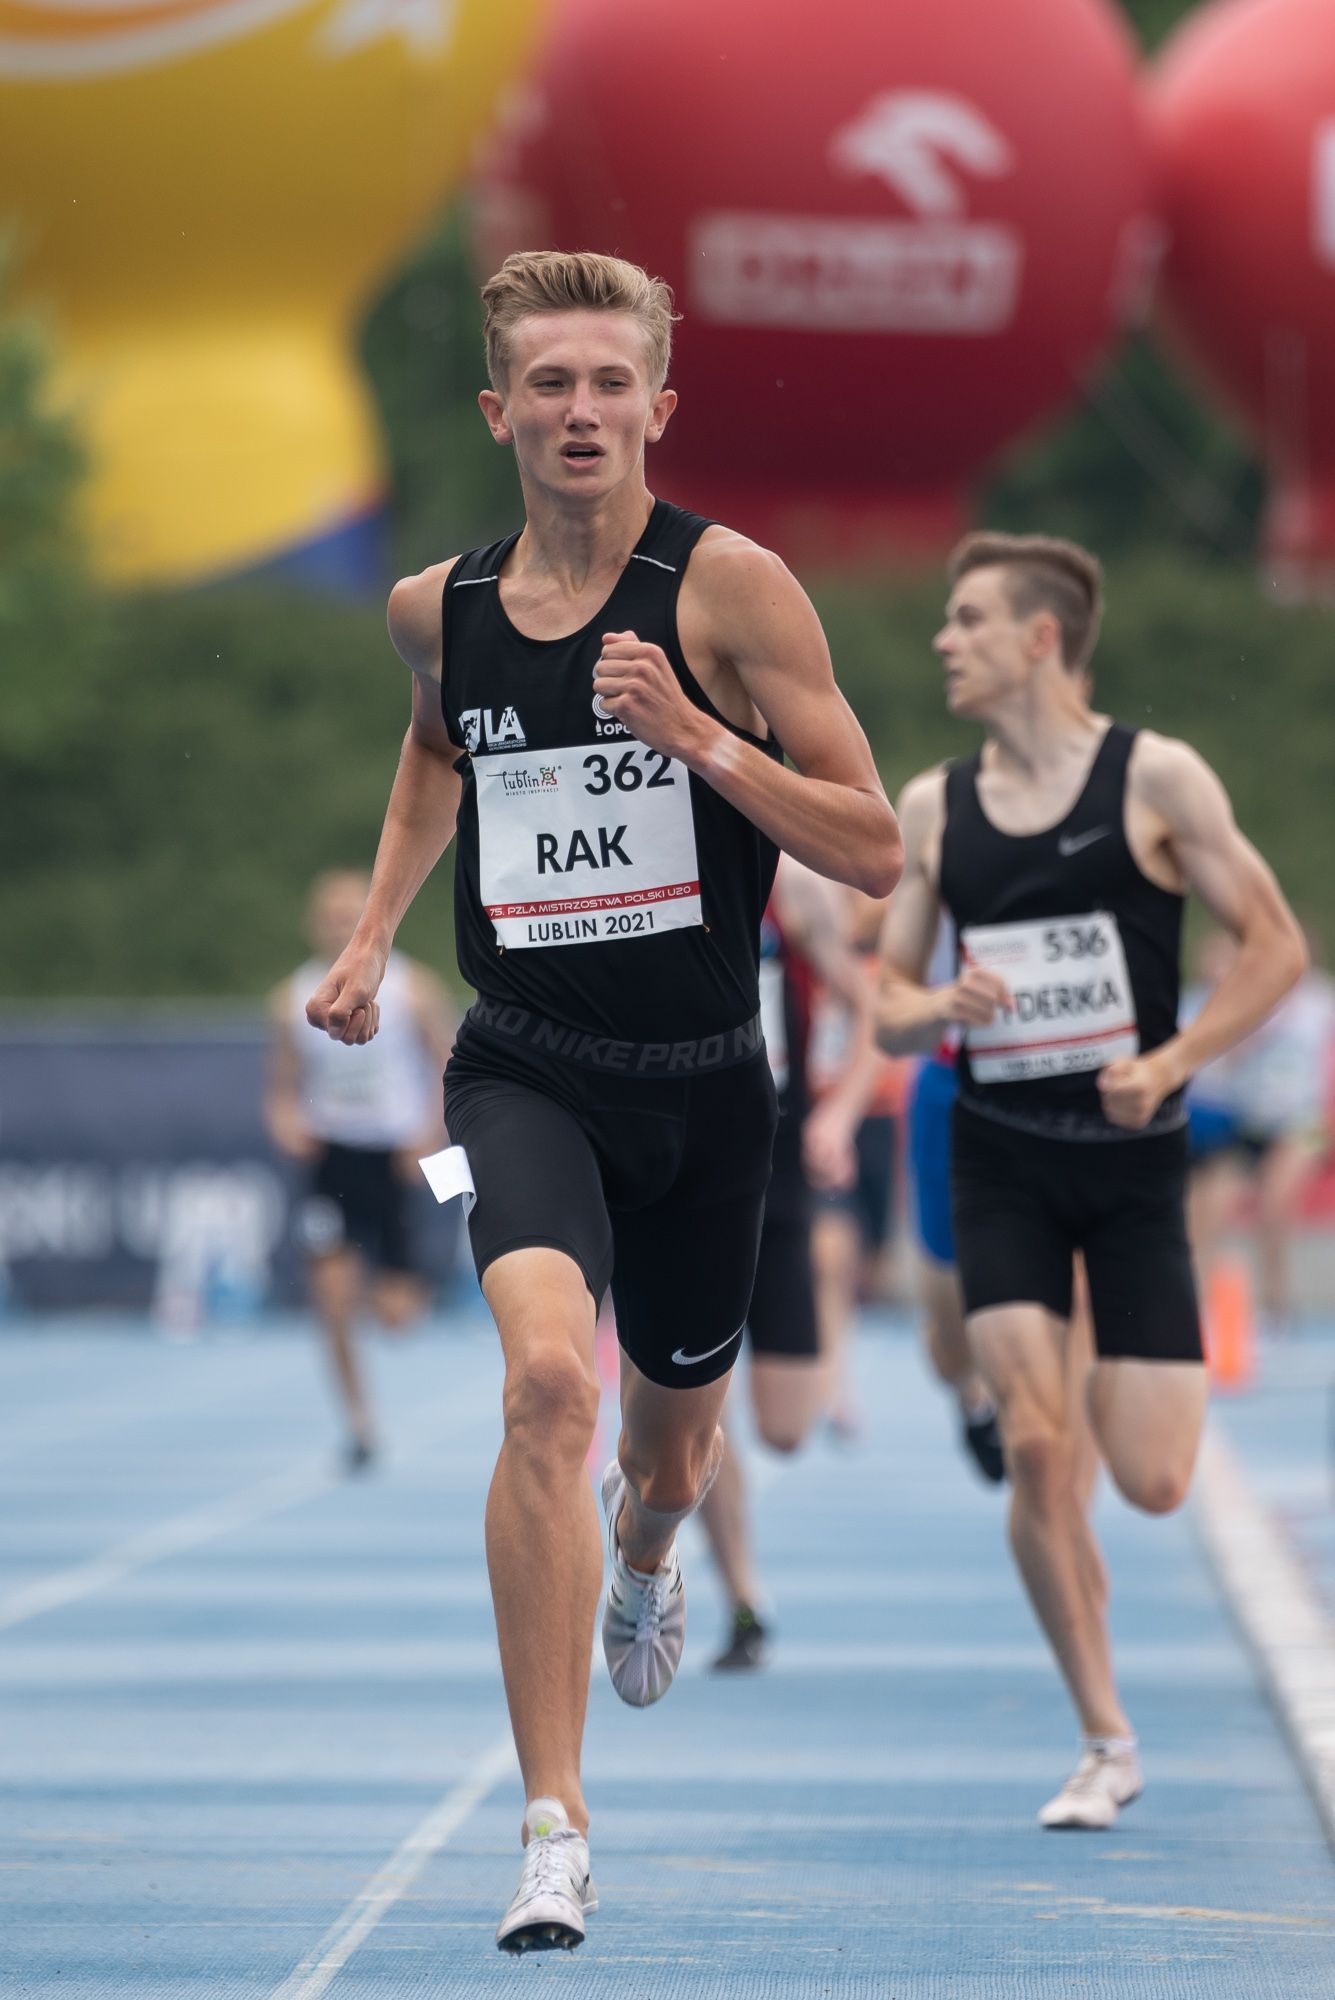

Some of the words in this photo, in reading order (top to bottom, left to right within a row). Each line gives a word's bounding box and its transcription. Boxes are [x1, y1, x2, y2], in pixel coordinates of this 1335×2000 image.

[582, 750, 676, 796] 362
[536, 825, 634, 875] RAK
[489, 907, 505, 917] 75.
[507, 904, 537, 916] PZLA
[538, 896, 622, 913] MISTRZOSTWA
[624, 890, 667, 905] POLSKI
[667, 885, 692, 897] U20
[528, 918, 598, 943] LUBLIN
[604, 911, 655, 936] 2021
[1043, 926, 1109, 963] 536
[476, 998, 531, 1036] RO
[530, 1018, 635, 1070] NIKE
[636, 1033, 725, 1072] PRO
